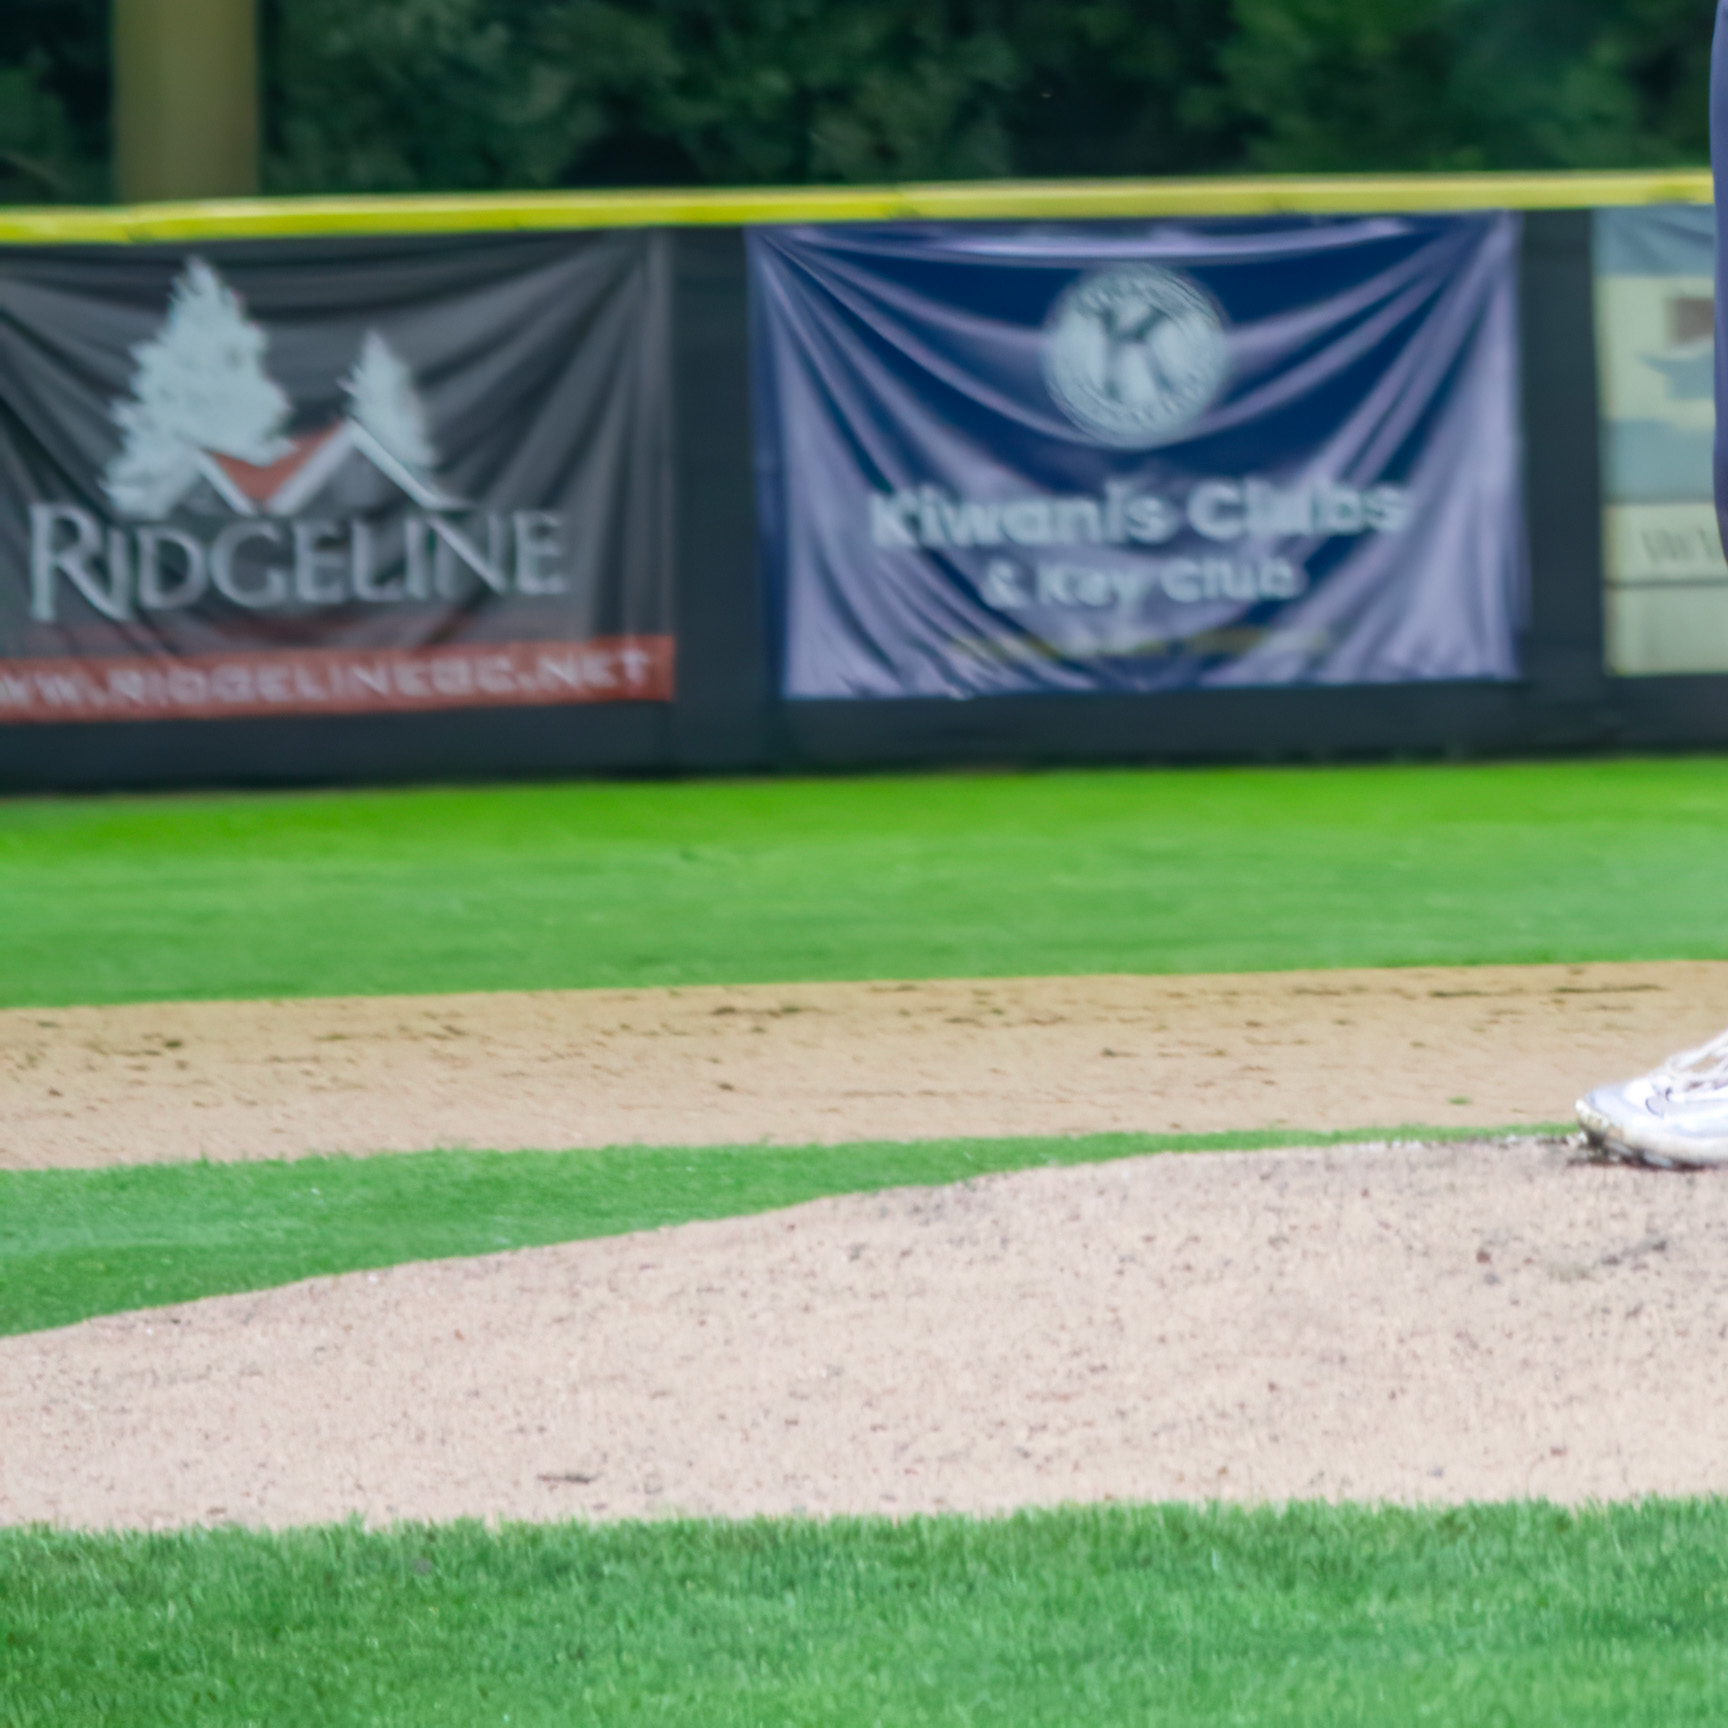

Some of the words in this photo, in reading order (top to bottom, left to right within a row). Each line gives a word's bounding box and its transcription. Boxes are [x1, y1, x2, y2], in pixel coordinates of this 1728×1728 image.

[868, 480, 1174, 547] Kiwanis
[1187, 476, 1411, 540] Clubs
[28, 501, 570, 621] RIDGELINE
[1160, 556, 1300, 603] Club
